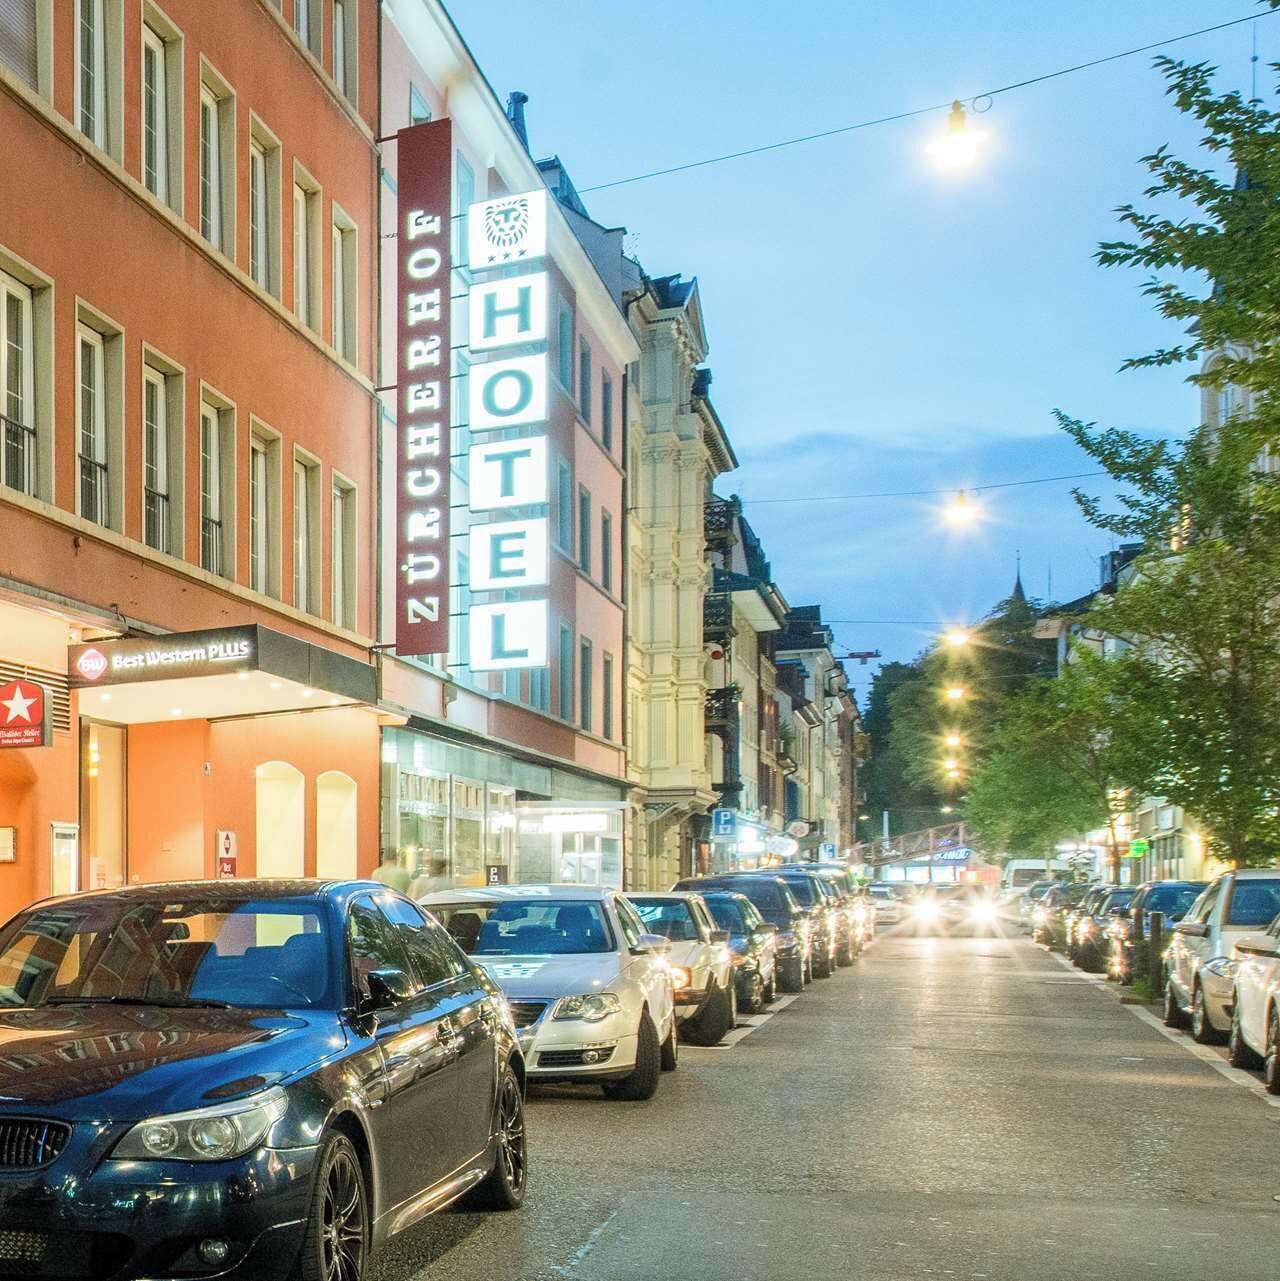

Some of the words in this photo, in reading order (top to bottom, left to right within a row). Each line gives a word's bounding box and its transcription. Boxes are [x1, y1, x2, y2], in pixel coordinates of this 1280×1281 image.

[402, 209, 441, 625] ZÜRCHERHOF
[482, 285, 534, 661] HOTEL
[112, 654, 145, 669] Best
[146, 648, 207, 665] Western
[208, 641, 249, 660] PLUS
[721, 811, 731, 824] P
